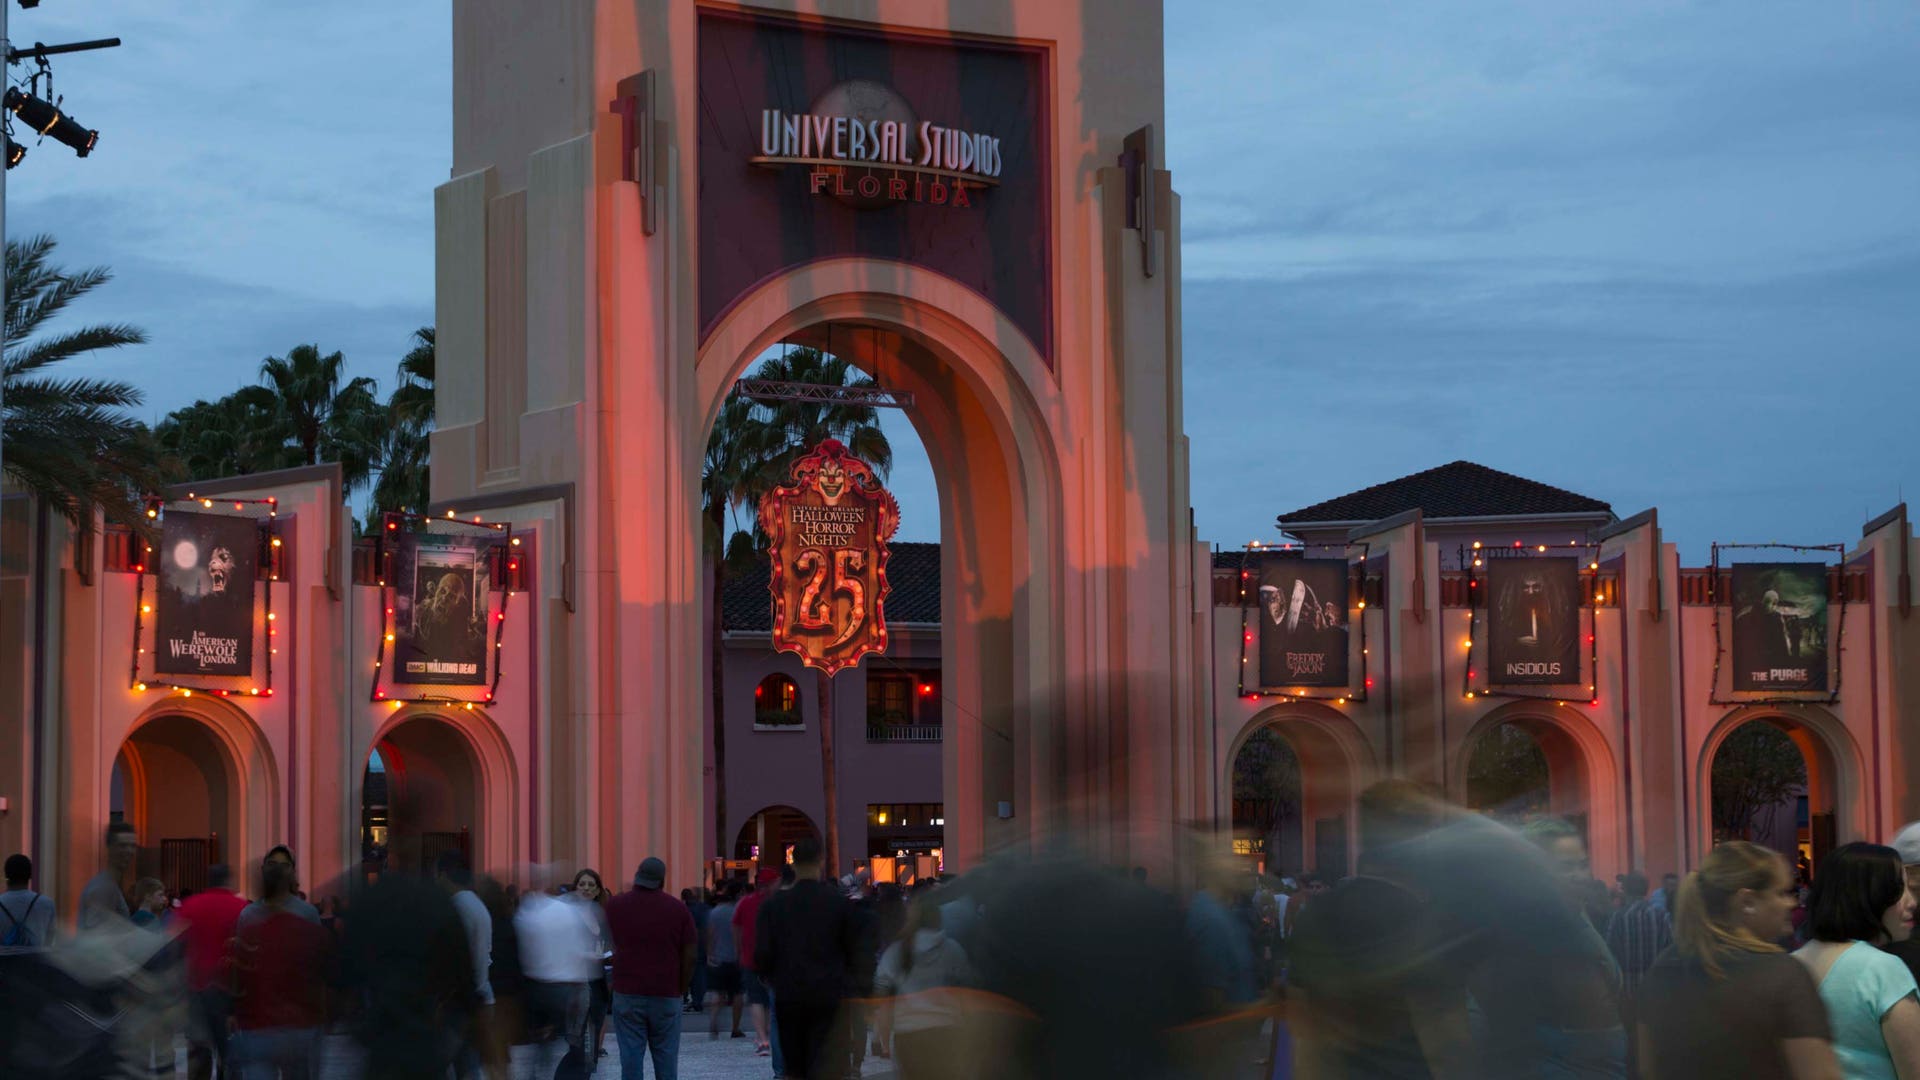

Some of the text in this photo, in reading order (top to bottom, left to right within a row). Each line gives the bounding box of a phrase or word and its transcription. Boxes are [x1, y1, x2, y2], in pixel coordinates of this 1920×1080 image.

[761, 109, 1001, 177] UNIVERSAL STUDIOS
[809, 172, 971, 208] FLORIDA
[792, 510, 864, 523] HALLOWEEN
[805, 521, 856, 535] HORROR
[798, 534, 848, 547] NIGHTS
[793, 550, 867, 650] 25
[191, 630, 238, 648] AMERICAN
[169, 639, 238, 659] WEREWOLF
[199, 653, 237, 667] LONDON
[1286, 652, 1325, 664] FREDDY
[459, 664, 477, 675] DEAD
[1292, 662, 1326, 677] JASON
[1507, 662, 1561, 676] INSIDIOUS
[1751, 668, 1808, 681] THE PURGE
